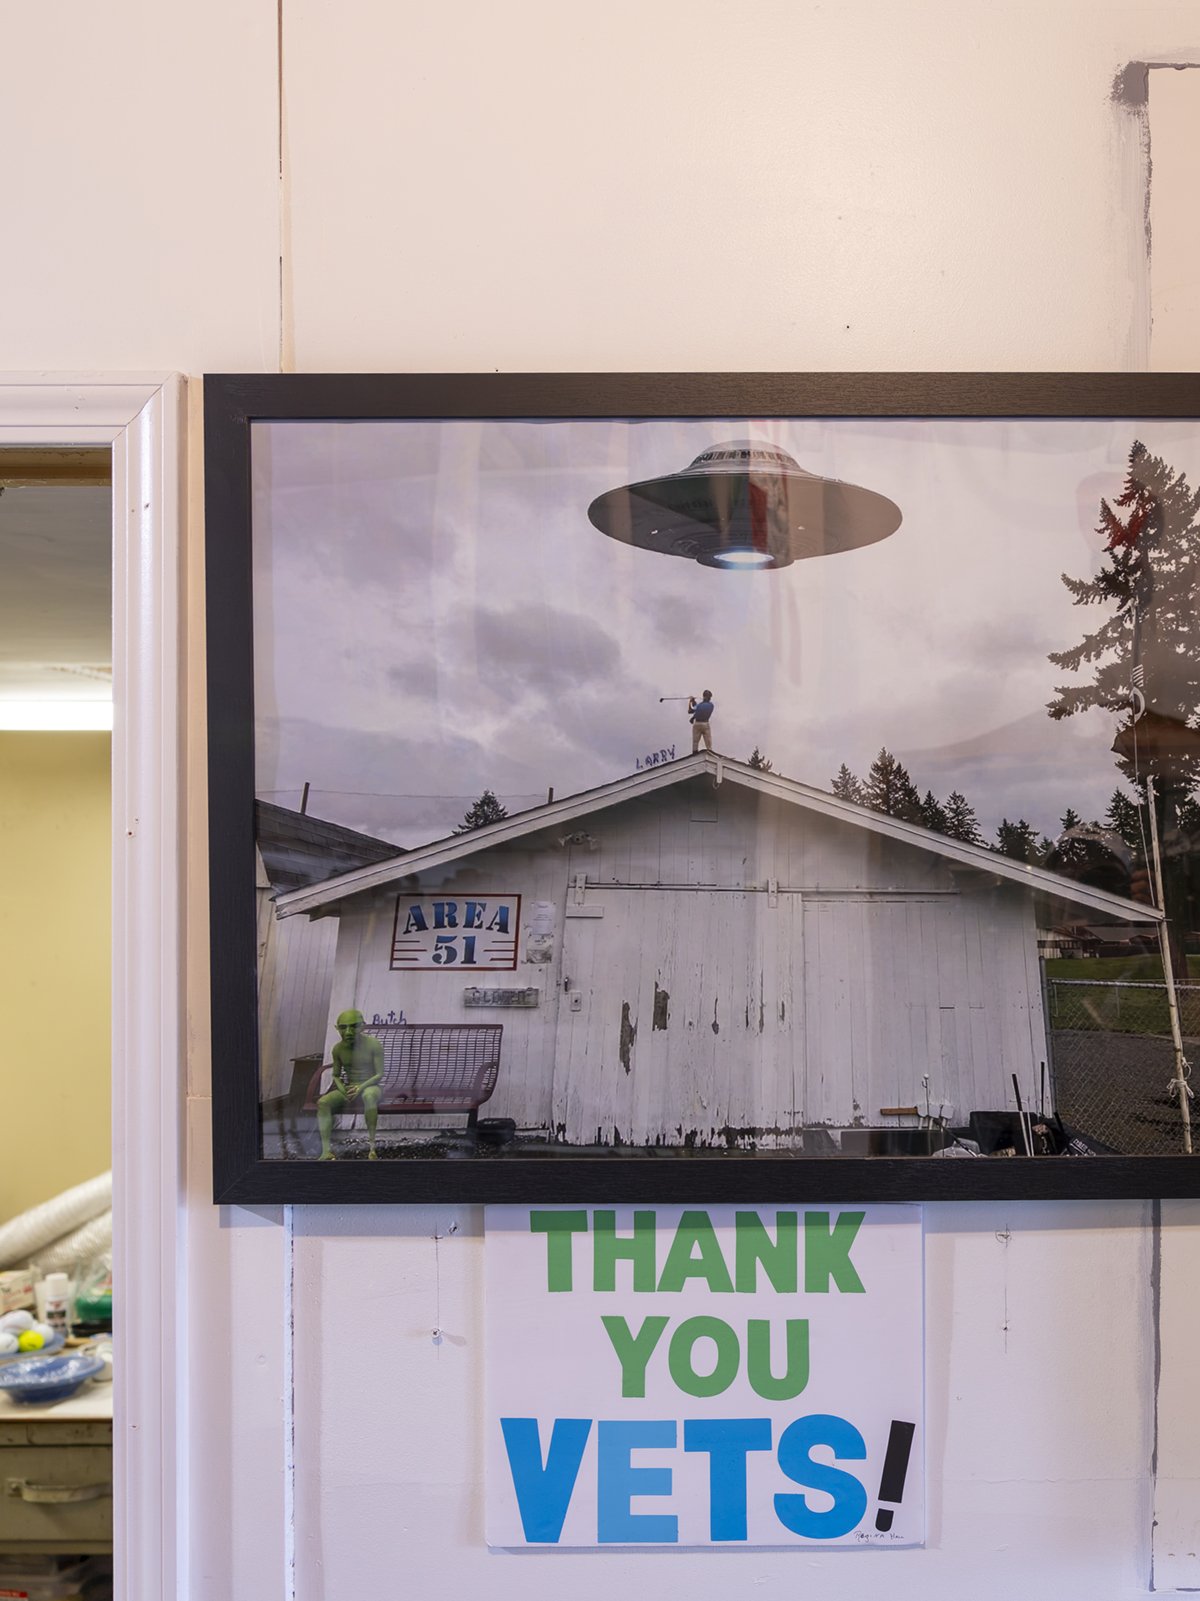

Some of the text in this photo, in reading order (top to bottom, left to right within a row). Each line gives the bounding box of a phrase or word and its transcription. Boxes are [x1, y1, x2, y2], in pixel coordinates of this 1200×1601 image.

[403, 901, 510, 935] AREA
[432, 935, 477, 965] 51
[372, 1010, 407, 1025] Butch
[530, 1210, 866, 1293] THANK
[600, 1315, 810, 1401] YOU
[500, 1413, 916, 1544] VETS!
